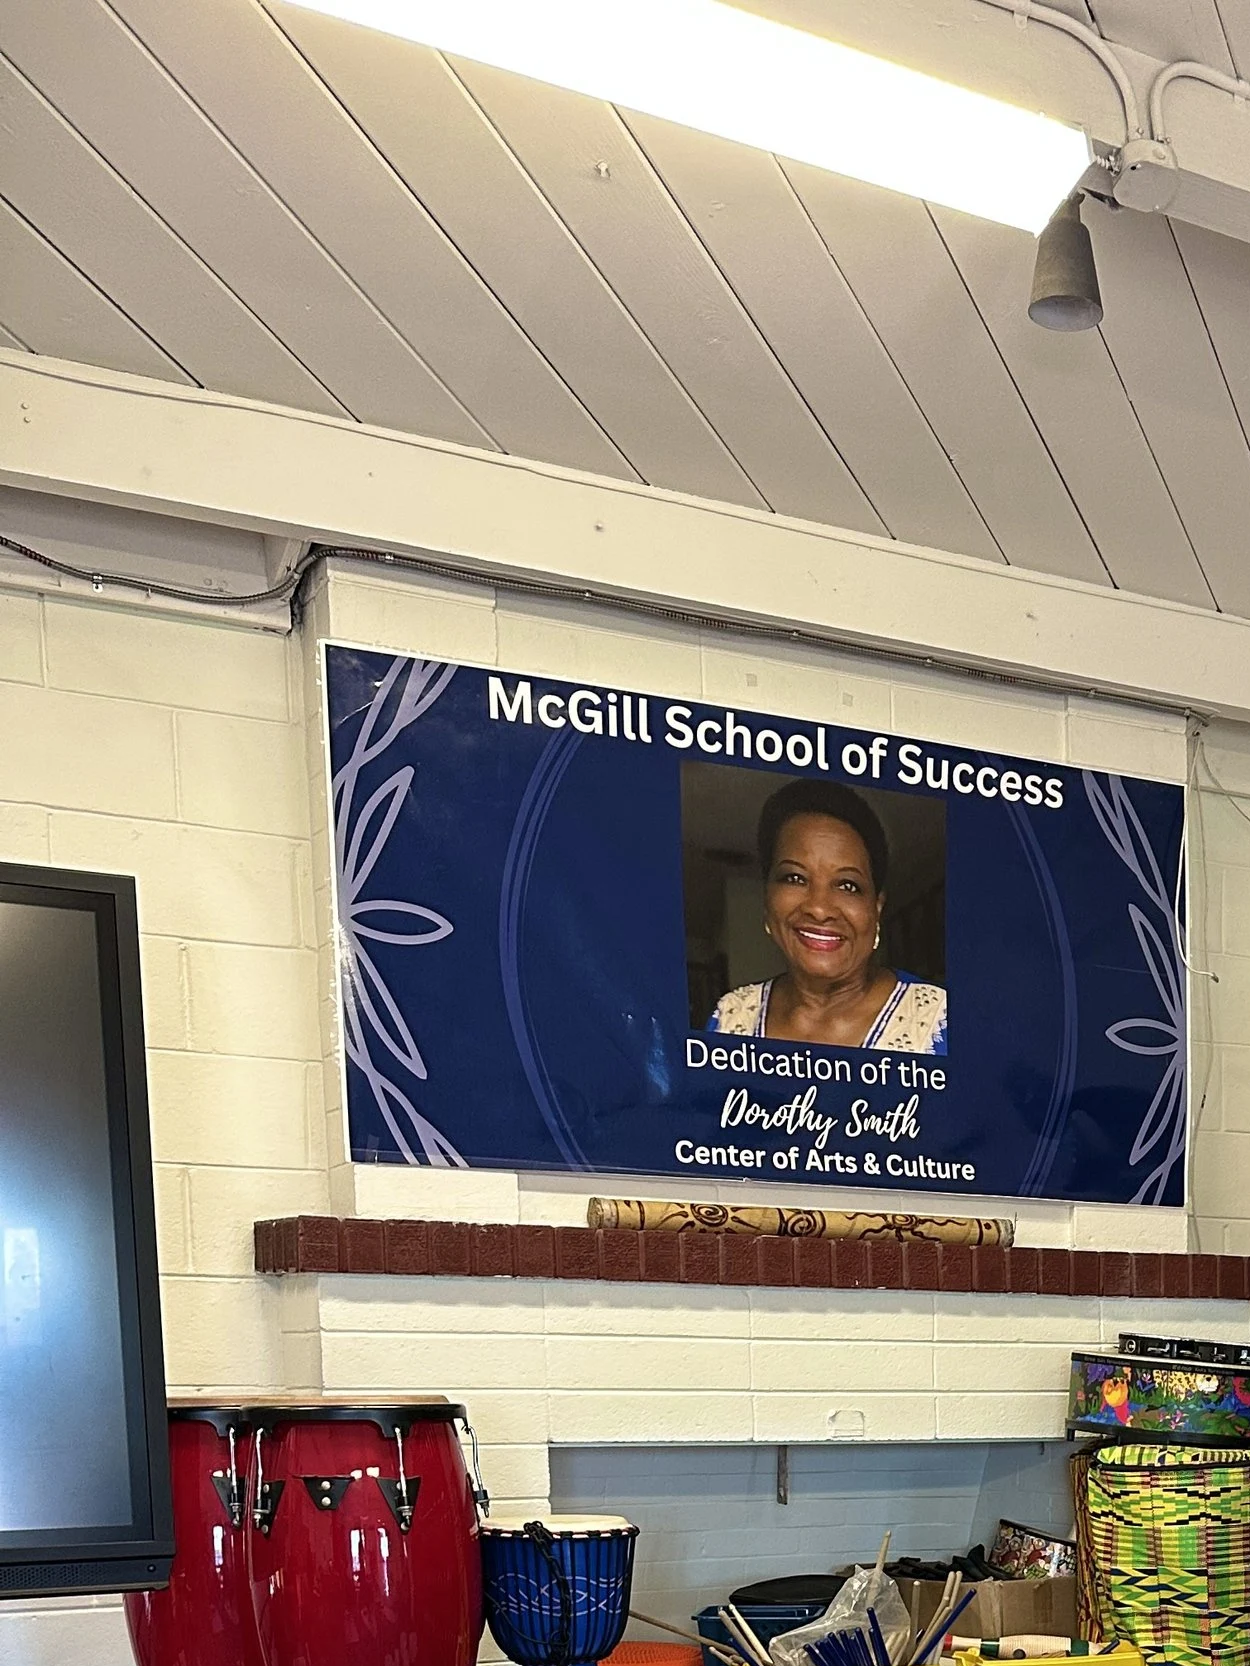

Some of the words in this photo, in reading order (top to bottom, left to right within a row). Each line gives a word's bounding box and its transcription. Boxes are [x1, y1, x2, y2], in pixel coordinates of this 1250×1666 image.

[488, 676, 652, 744] McGill
[664, 705, 830, 771] School
[841, 736, 889, 779] of
[897, 743, 1064, 809] Success
[686, 1038, 852, 1083] Dedication
[860, 1056, 892, 1086] of
[897, 1059, 946, 1091] the
[720, 1085, 839, 1150] Dorothy
[845, 1093, 921, 1143] Smith
[675, 1139, 767, 1168] Center
[772, 1146, 800, 1170] of
[805, 1148, 858, 1174] Arts
[863, 1152, 882, 1175] &
[886, 1153, 976, 1181] Culture
